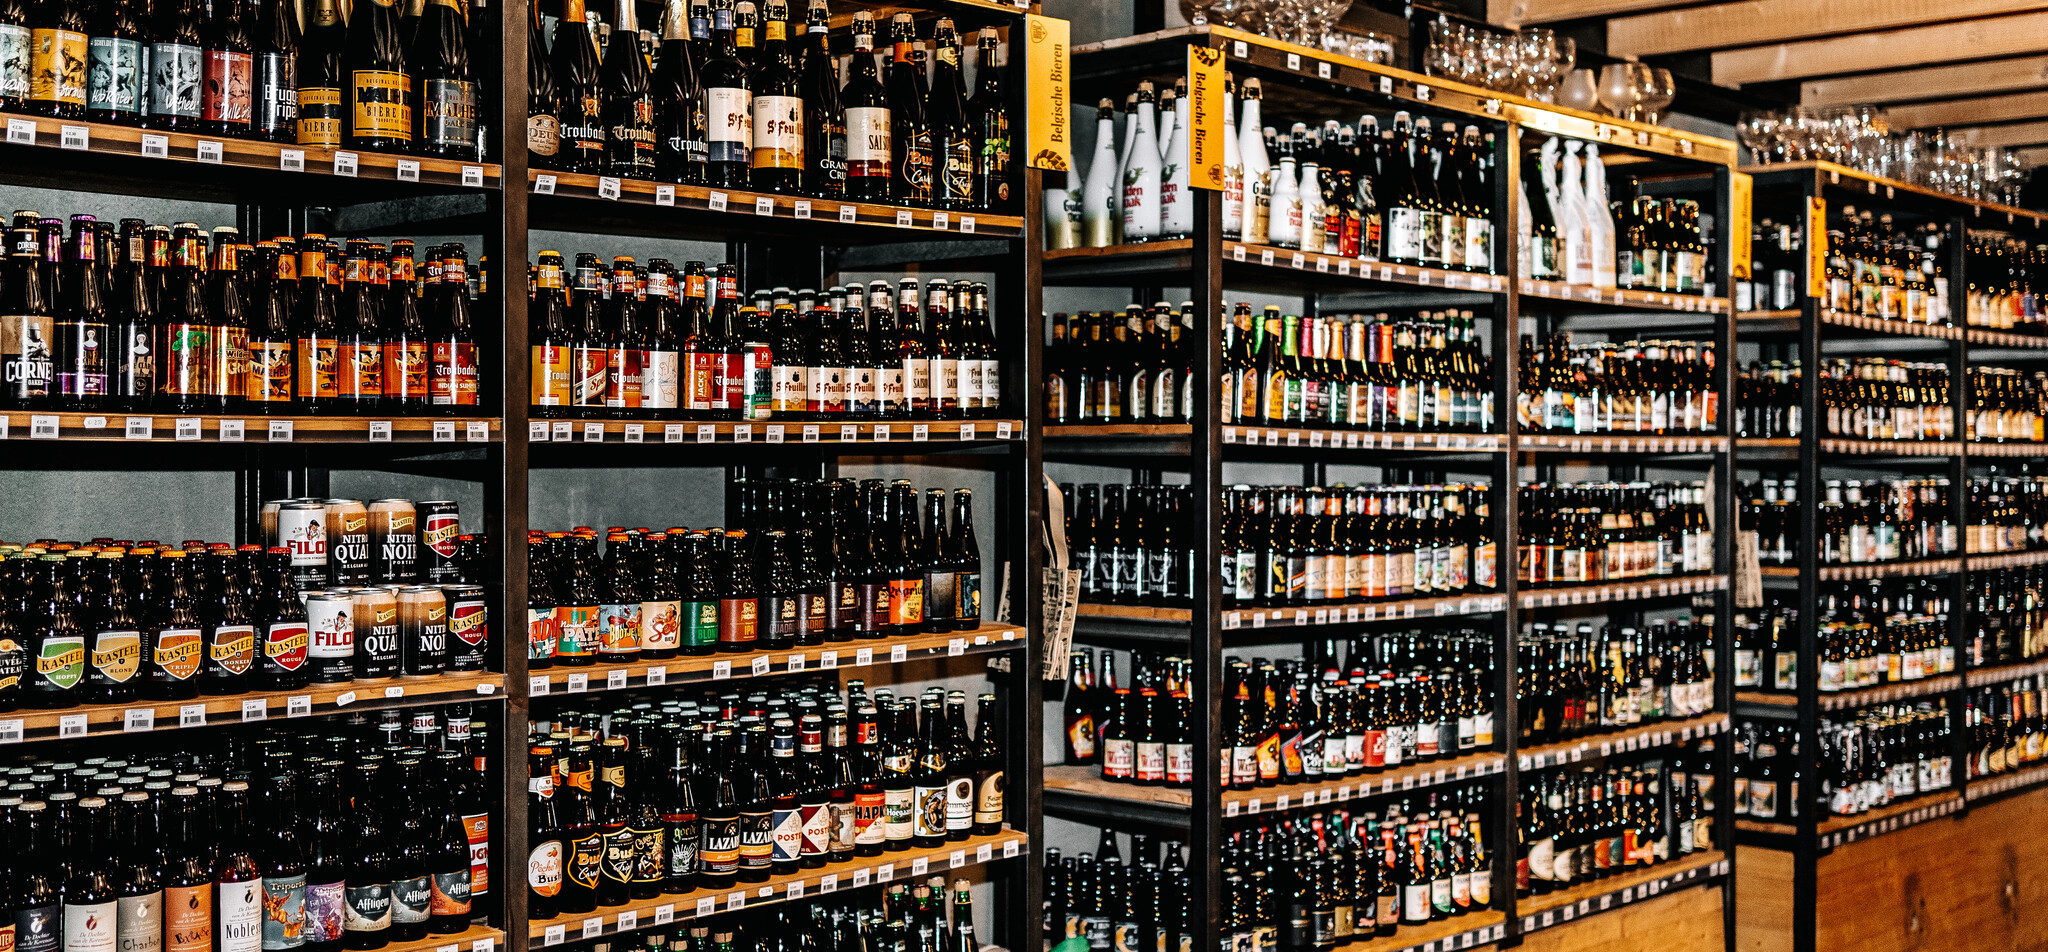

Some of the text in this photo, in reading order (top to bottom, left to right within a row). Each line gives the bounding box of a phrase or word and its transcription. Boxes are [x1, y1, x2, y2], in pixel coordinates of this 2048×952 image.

[1050, 43, 1064, 143] Belgische Bieren
[1195, 71, 1206, 165] Belgische Bieren
[17, 241, 39, 250] CORNET
[744, 625, 755, 636] IPA
[96, 644, 139, 665] KASTEEL
[159, 644, 200, 663] KASTEEL
[214, 639, 253, 659] KASTEEL
[269, 635, 307, 656] KASTEEL
[41, 650, 83, 671] KASTEEL
[55, 673, 77, 681] HOPPY
